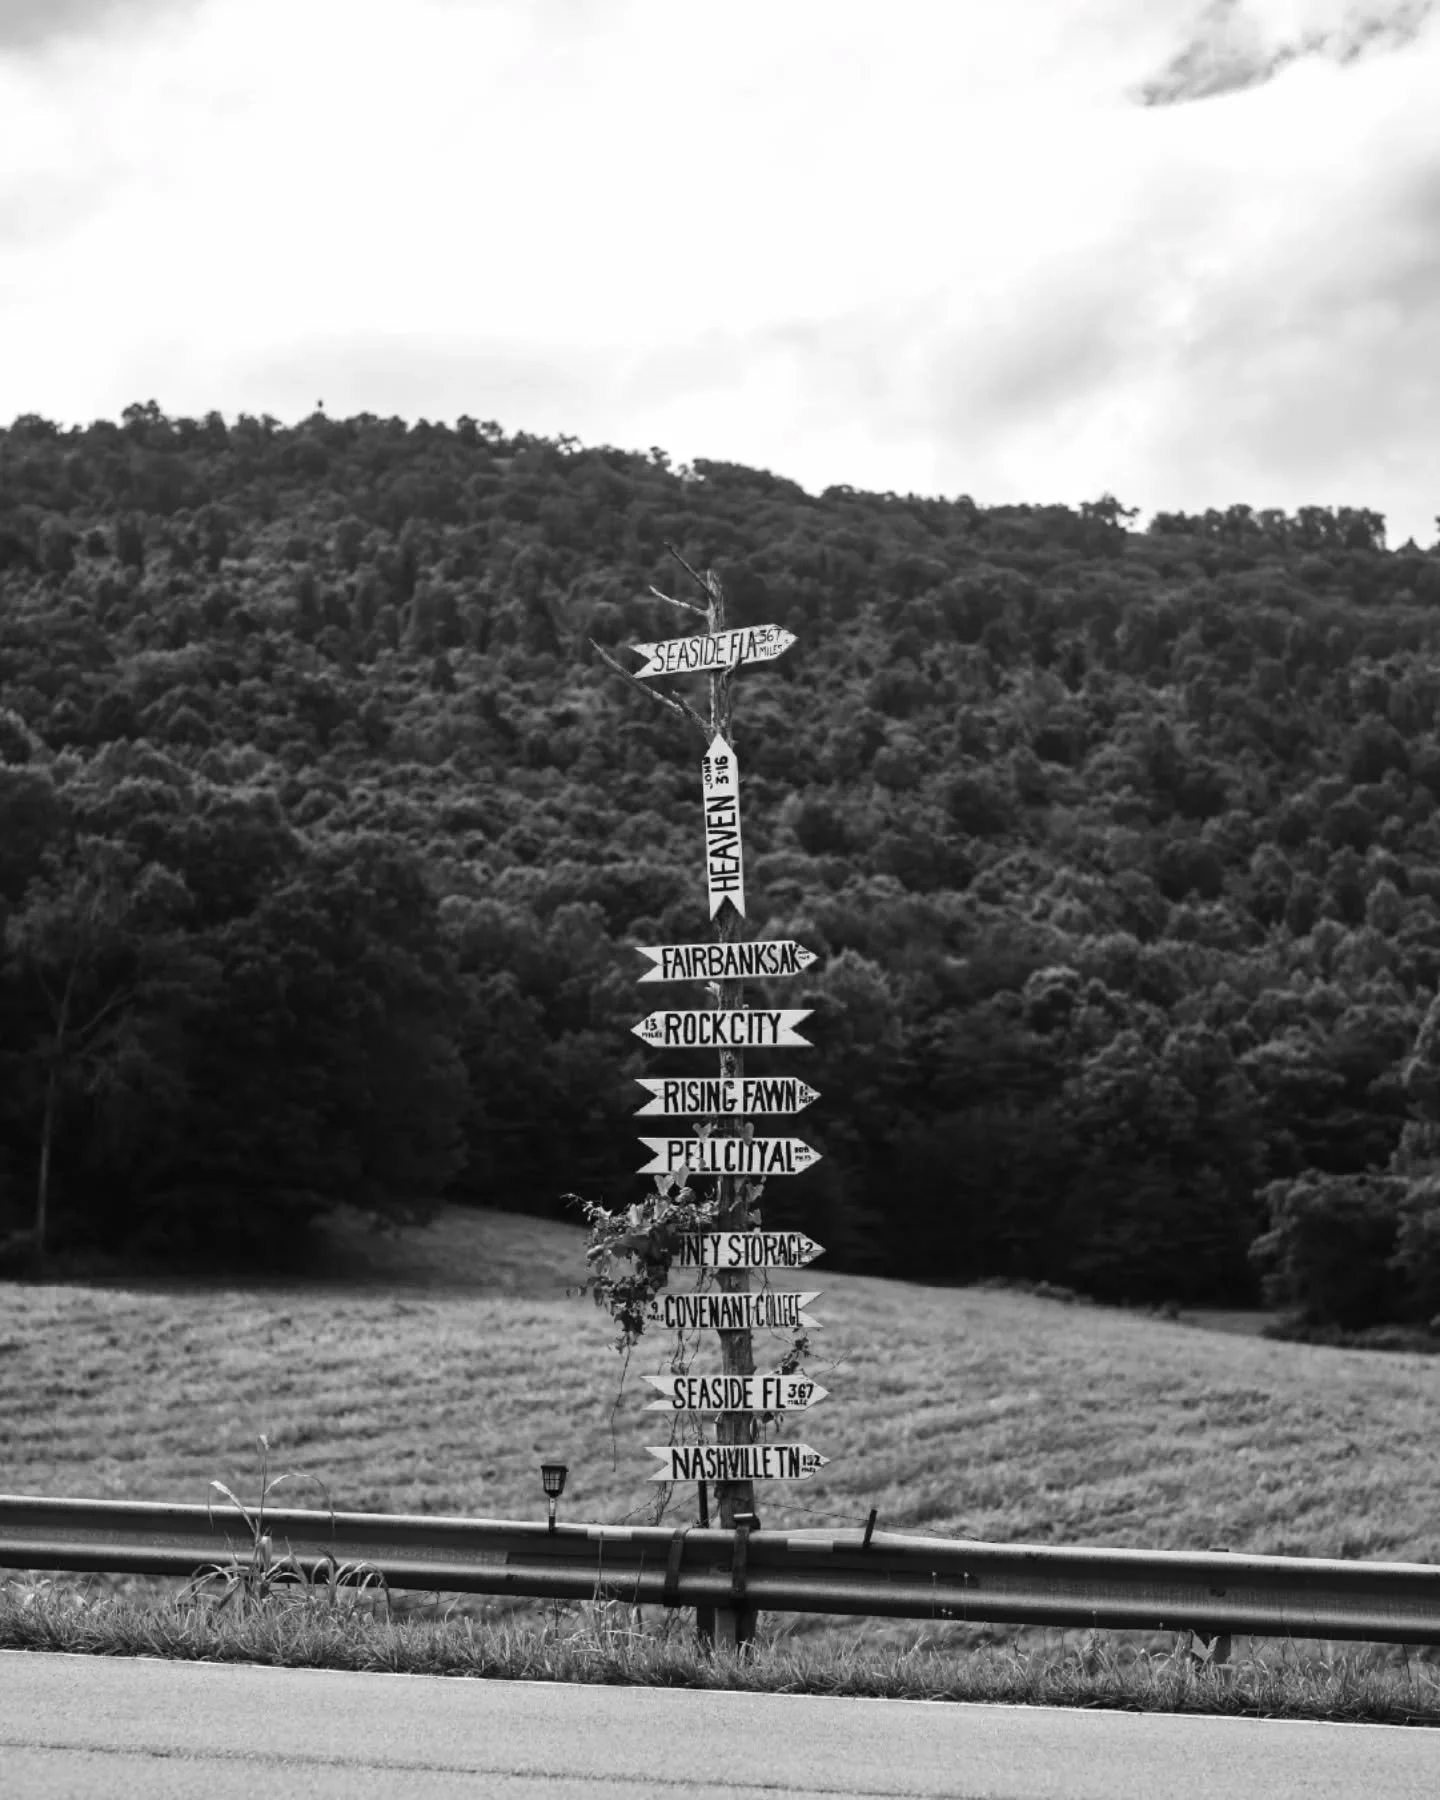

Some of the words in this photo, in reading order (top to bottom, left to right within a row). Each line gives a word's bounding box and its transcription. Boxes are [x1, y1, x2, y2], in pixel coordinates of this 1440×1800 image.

[653, 635, 726, 672] SEASIDE
[759, 645, 783, 656] MILES
[714, 755, 729, 784] 3:16
[706, 795, 740, 892] HEAVEN
[645, 1018, 658, 1031] 13
[664, 1080, 738, 1113] RISING
[742, 1080, 796, 1112] FAWN
[728, 1234, 807, 1266] STORAGE
[651, 1302, 659, 1313] 9
[664, 1295, 752, 1328] COVENANT
[755, 1294, 804, 1328] COLLEGE
[672, 1378, 753, 1409] SEASIDE
[763, 1378, 786, 1408] FL
[787, 1384, 814, 1399] 367
